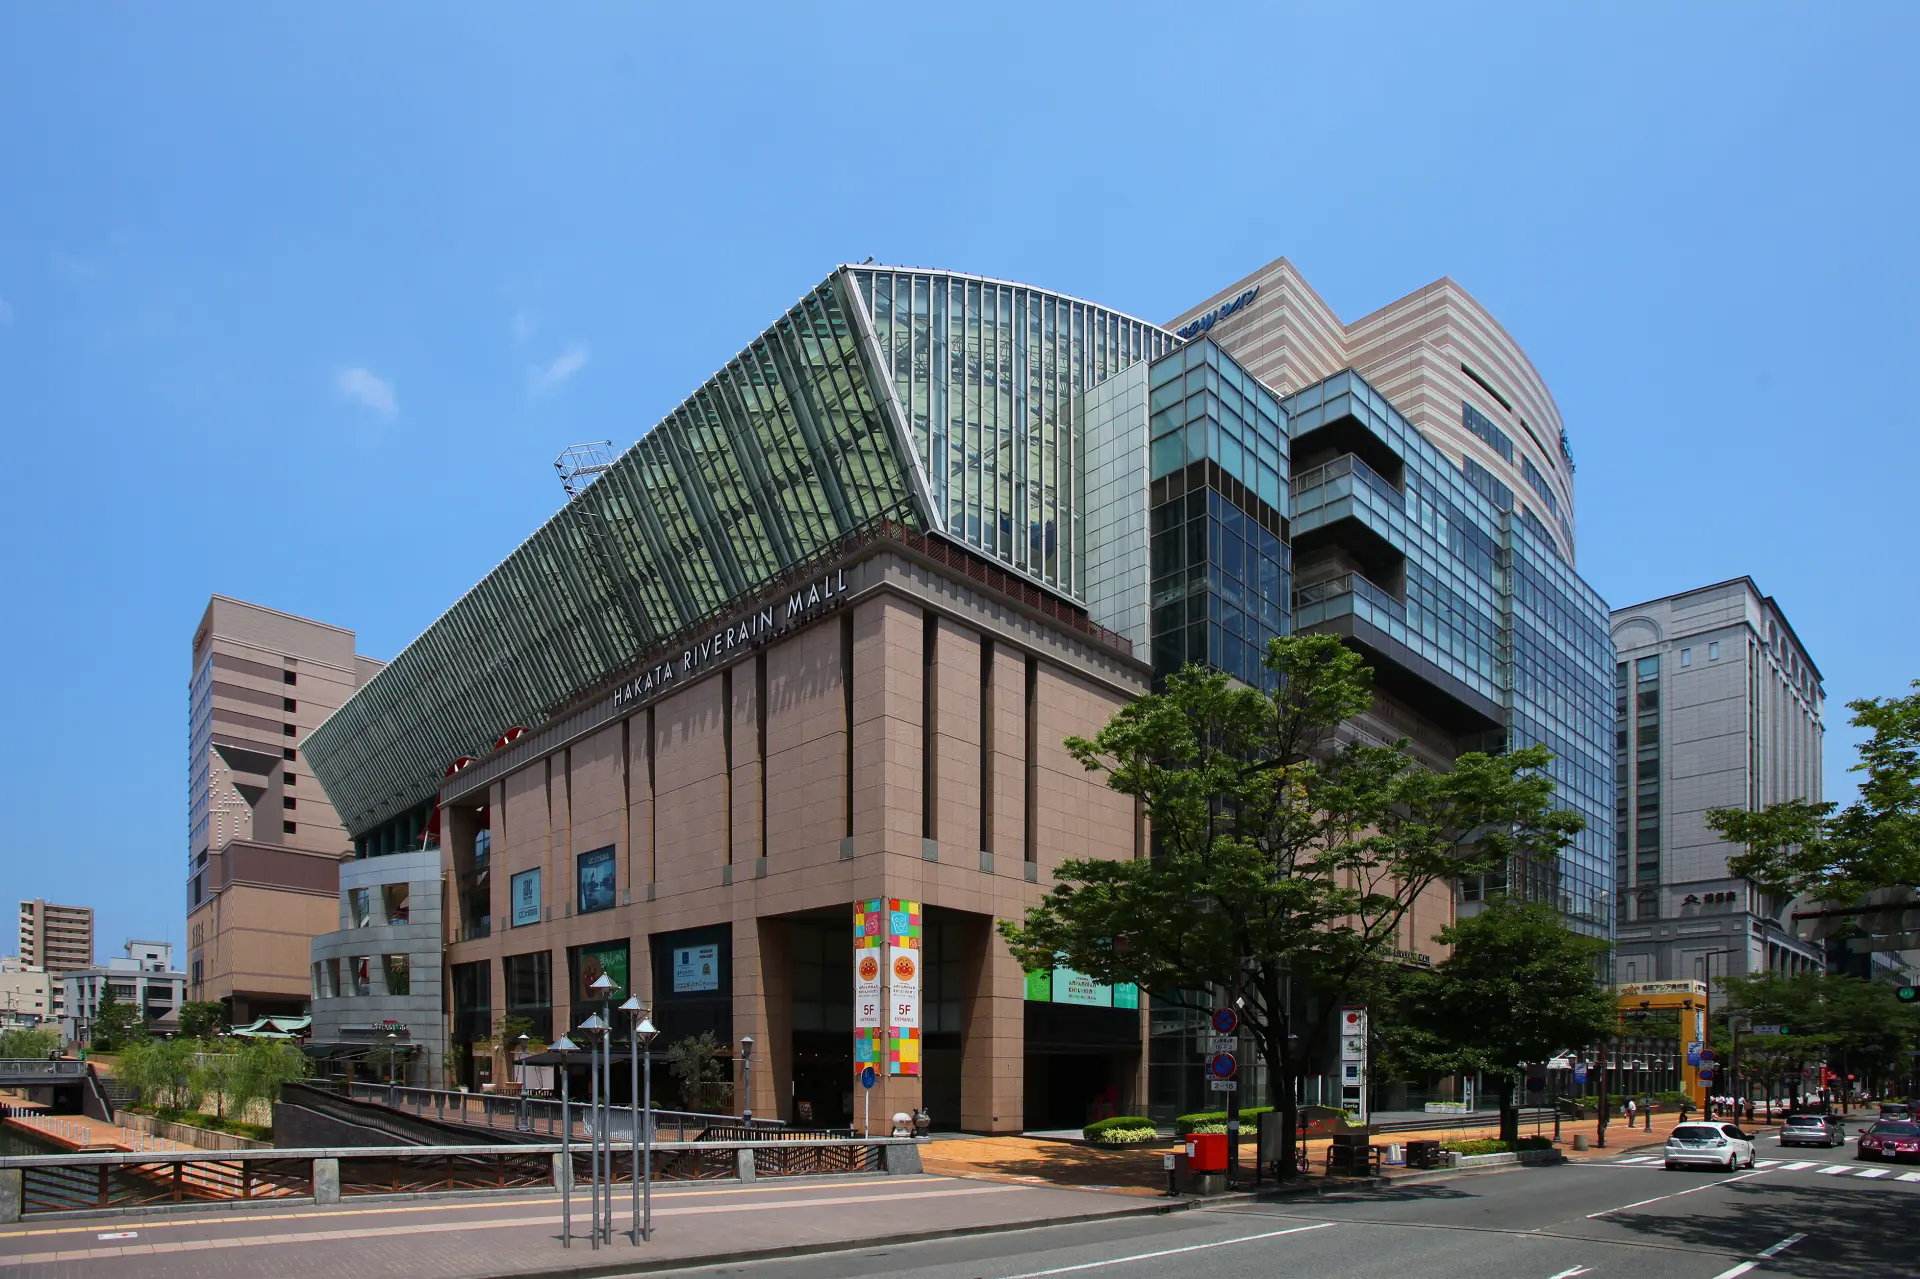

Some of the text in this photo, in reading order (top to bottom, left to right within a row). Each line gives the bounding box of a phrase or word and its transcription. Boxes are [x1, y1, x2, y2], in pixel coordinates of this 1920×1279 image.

[613, 568, 849, 708] HAKATA RIVERAIN MALL
[863, 1004, 875, 1015] 5F
[898, 1004, 911, 1015] 5F
